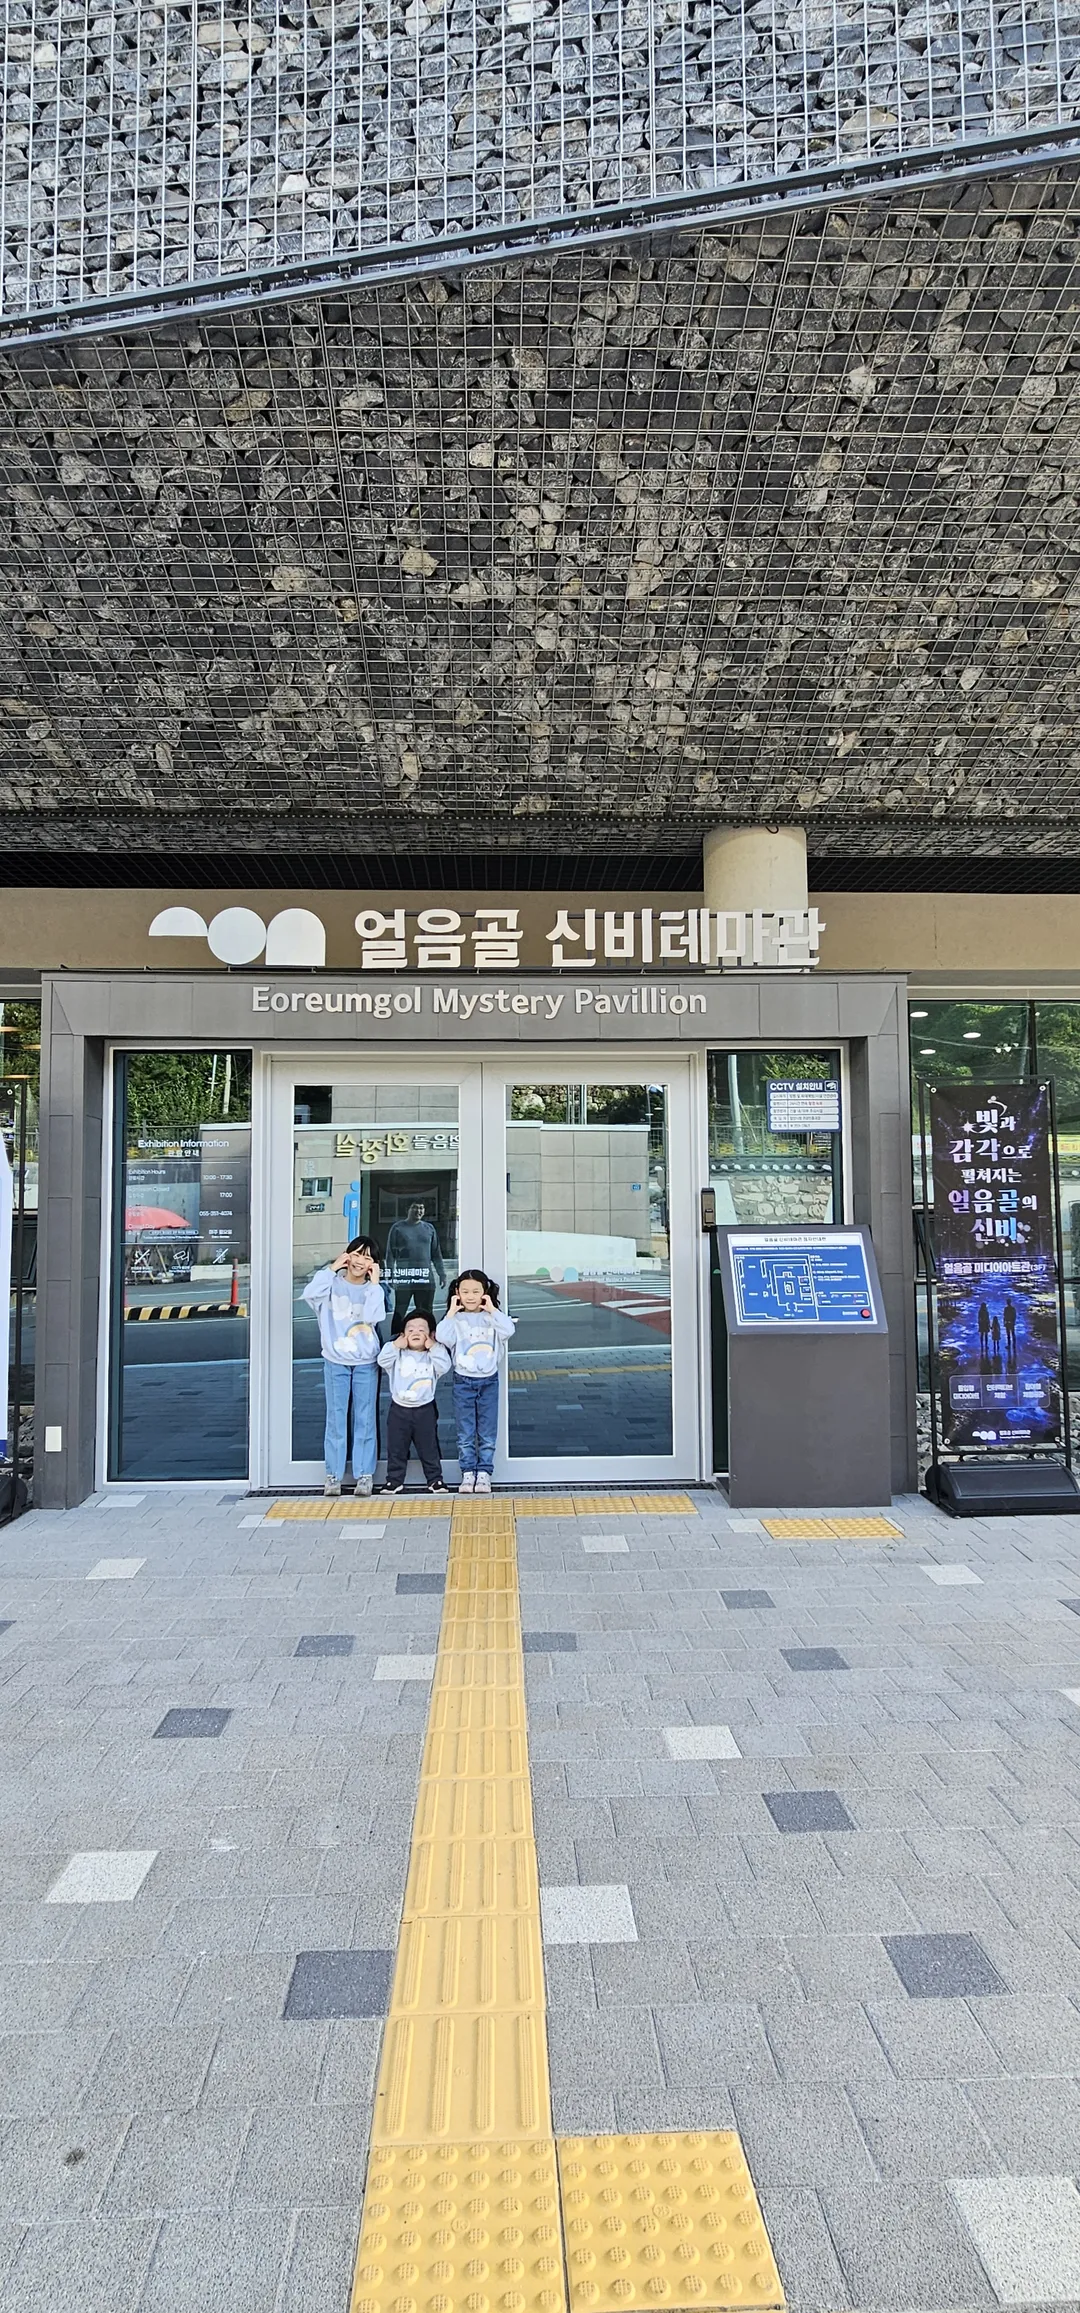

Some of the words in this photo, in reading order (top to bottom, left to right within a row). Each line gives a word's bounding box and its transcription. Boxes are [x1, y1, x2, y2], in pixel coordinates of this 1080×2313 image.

[354, 908, 523, 969] 얼음골
[546, 907, 826, 968] 신비테마관
[252, 986, 421, 1019] Eoreumgol
[433, 987, 564, 1020] Mystery
[575, 987, 706, 1014] Pavillion
[769, 1082, 794, 1091] CCTV
[973, 1108, 1016, 1133] 빛과
[137, 1139, 179, 1148] Exhibition
[180, 1139, 230, 1148] Information
[949, 1138, 1033, 1163] 감각으로
[961, 1168, 1022, 1184] 펼쳐지는
[948, 1188, 1037, 1214] 얼음골의
[970, 1217, 1018, 1243] 신비
